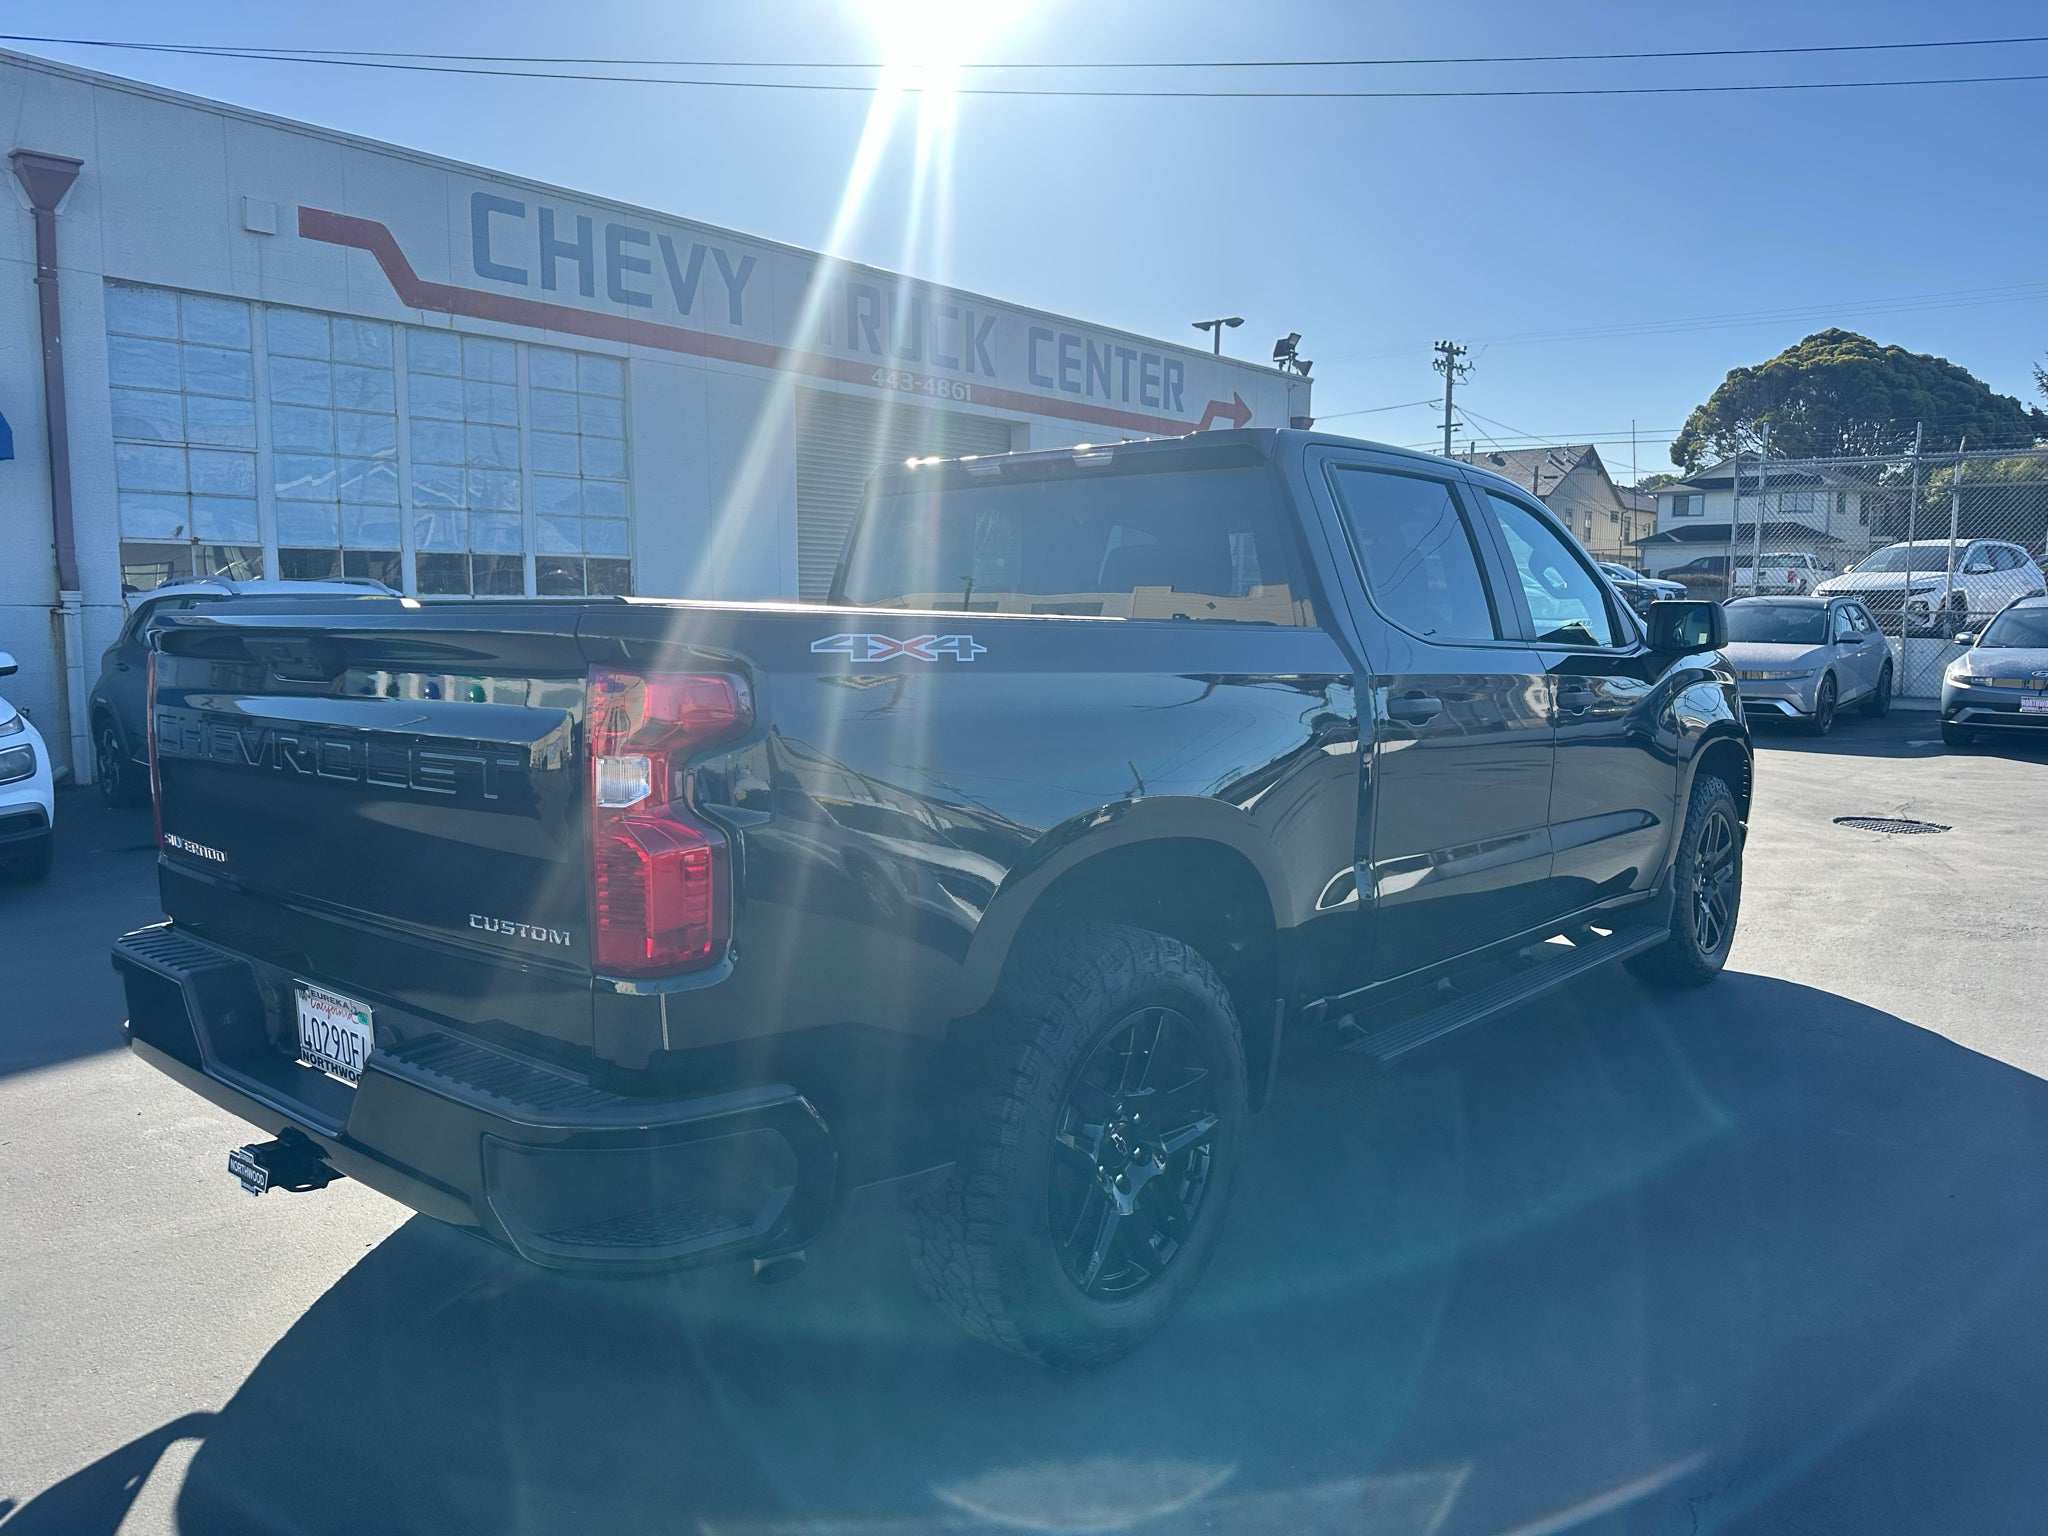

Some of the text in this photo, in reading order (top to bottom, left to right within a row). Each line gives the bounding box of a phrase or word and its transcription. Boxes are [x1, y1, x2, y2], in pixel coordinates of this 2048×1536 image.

[471, 191, 1185, 413] CHEVY TRUCK CENTER
[871, 366, 972, 402] 443-4861
[156, 711, 522, 800] CHEVROLET
[469, 913, 571, 946] CUSTOM
[310, 990, 349, 1010] EUREKA
[230, 1158, 265, 1186] NORTHWOOD
